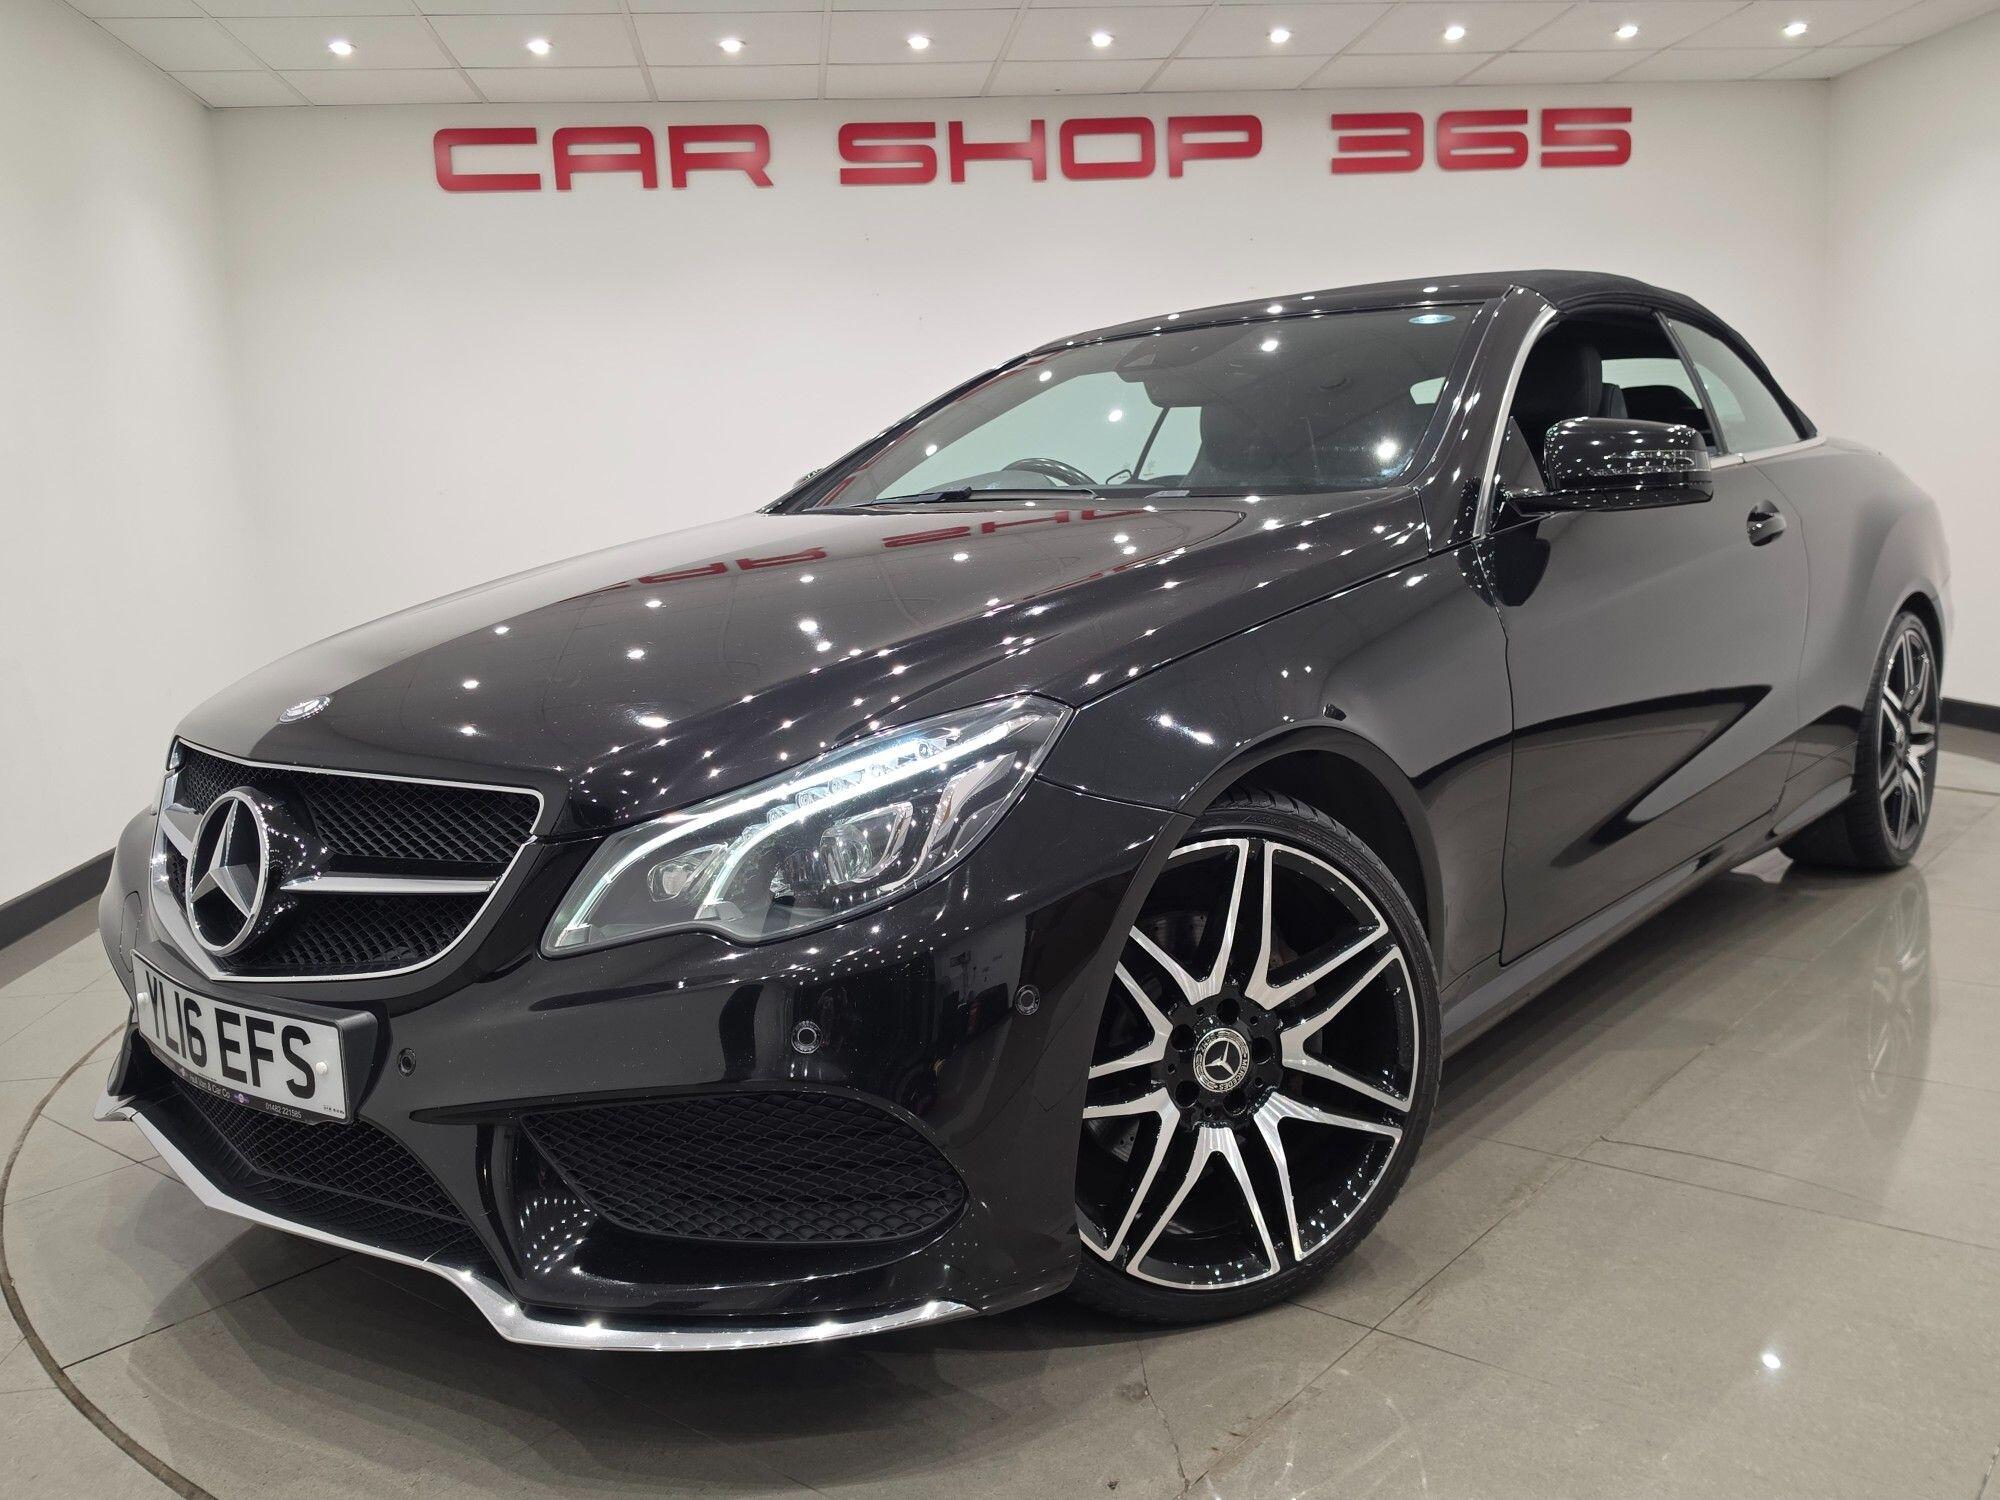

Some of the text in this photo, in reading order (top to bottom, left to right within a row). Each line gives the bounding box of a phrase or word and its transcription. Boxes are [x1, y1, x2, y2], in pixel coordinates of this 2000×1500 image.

[433, 106, 1633, 192] CAR SHOP 365
[146, 970, 315, 1100] YL16 EFS
[1219, 1059, 1248, 1090] MERCEDES
